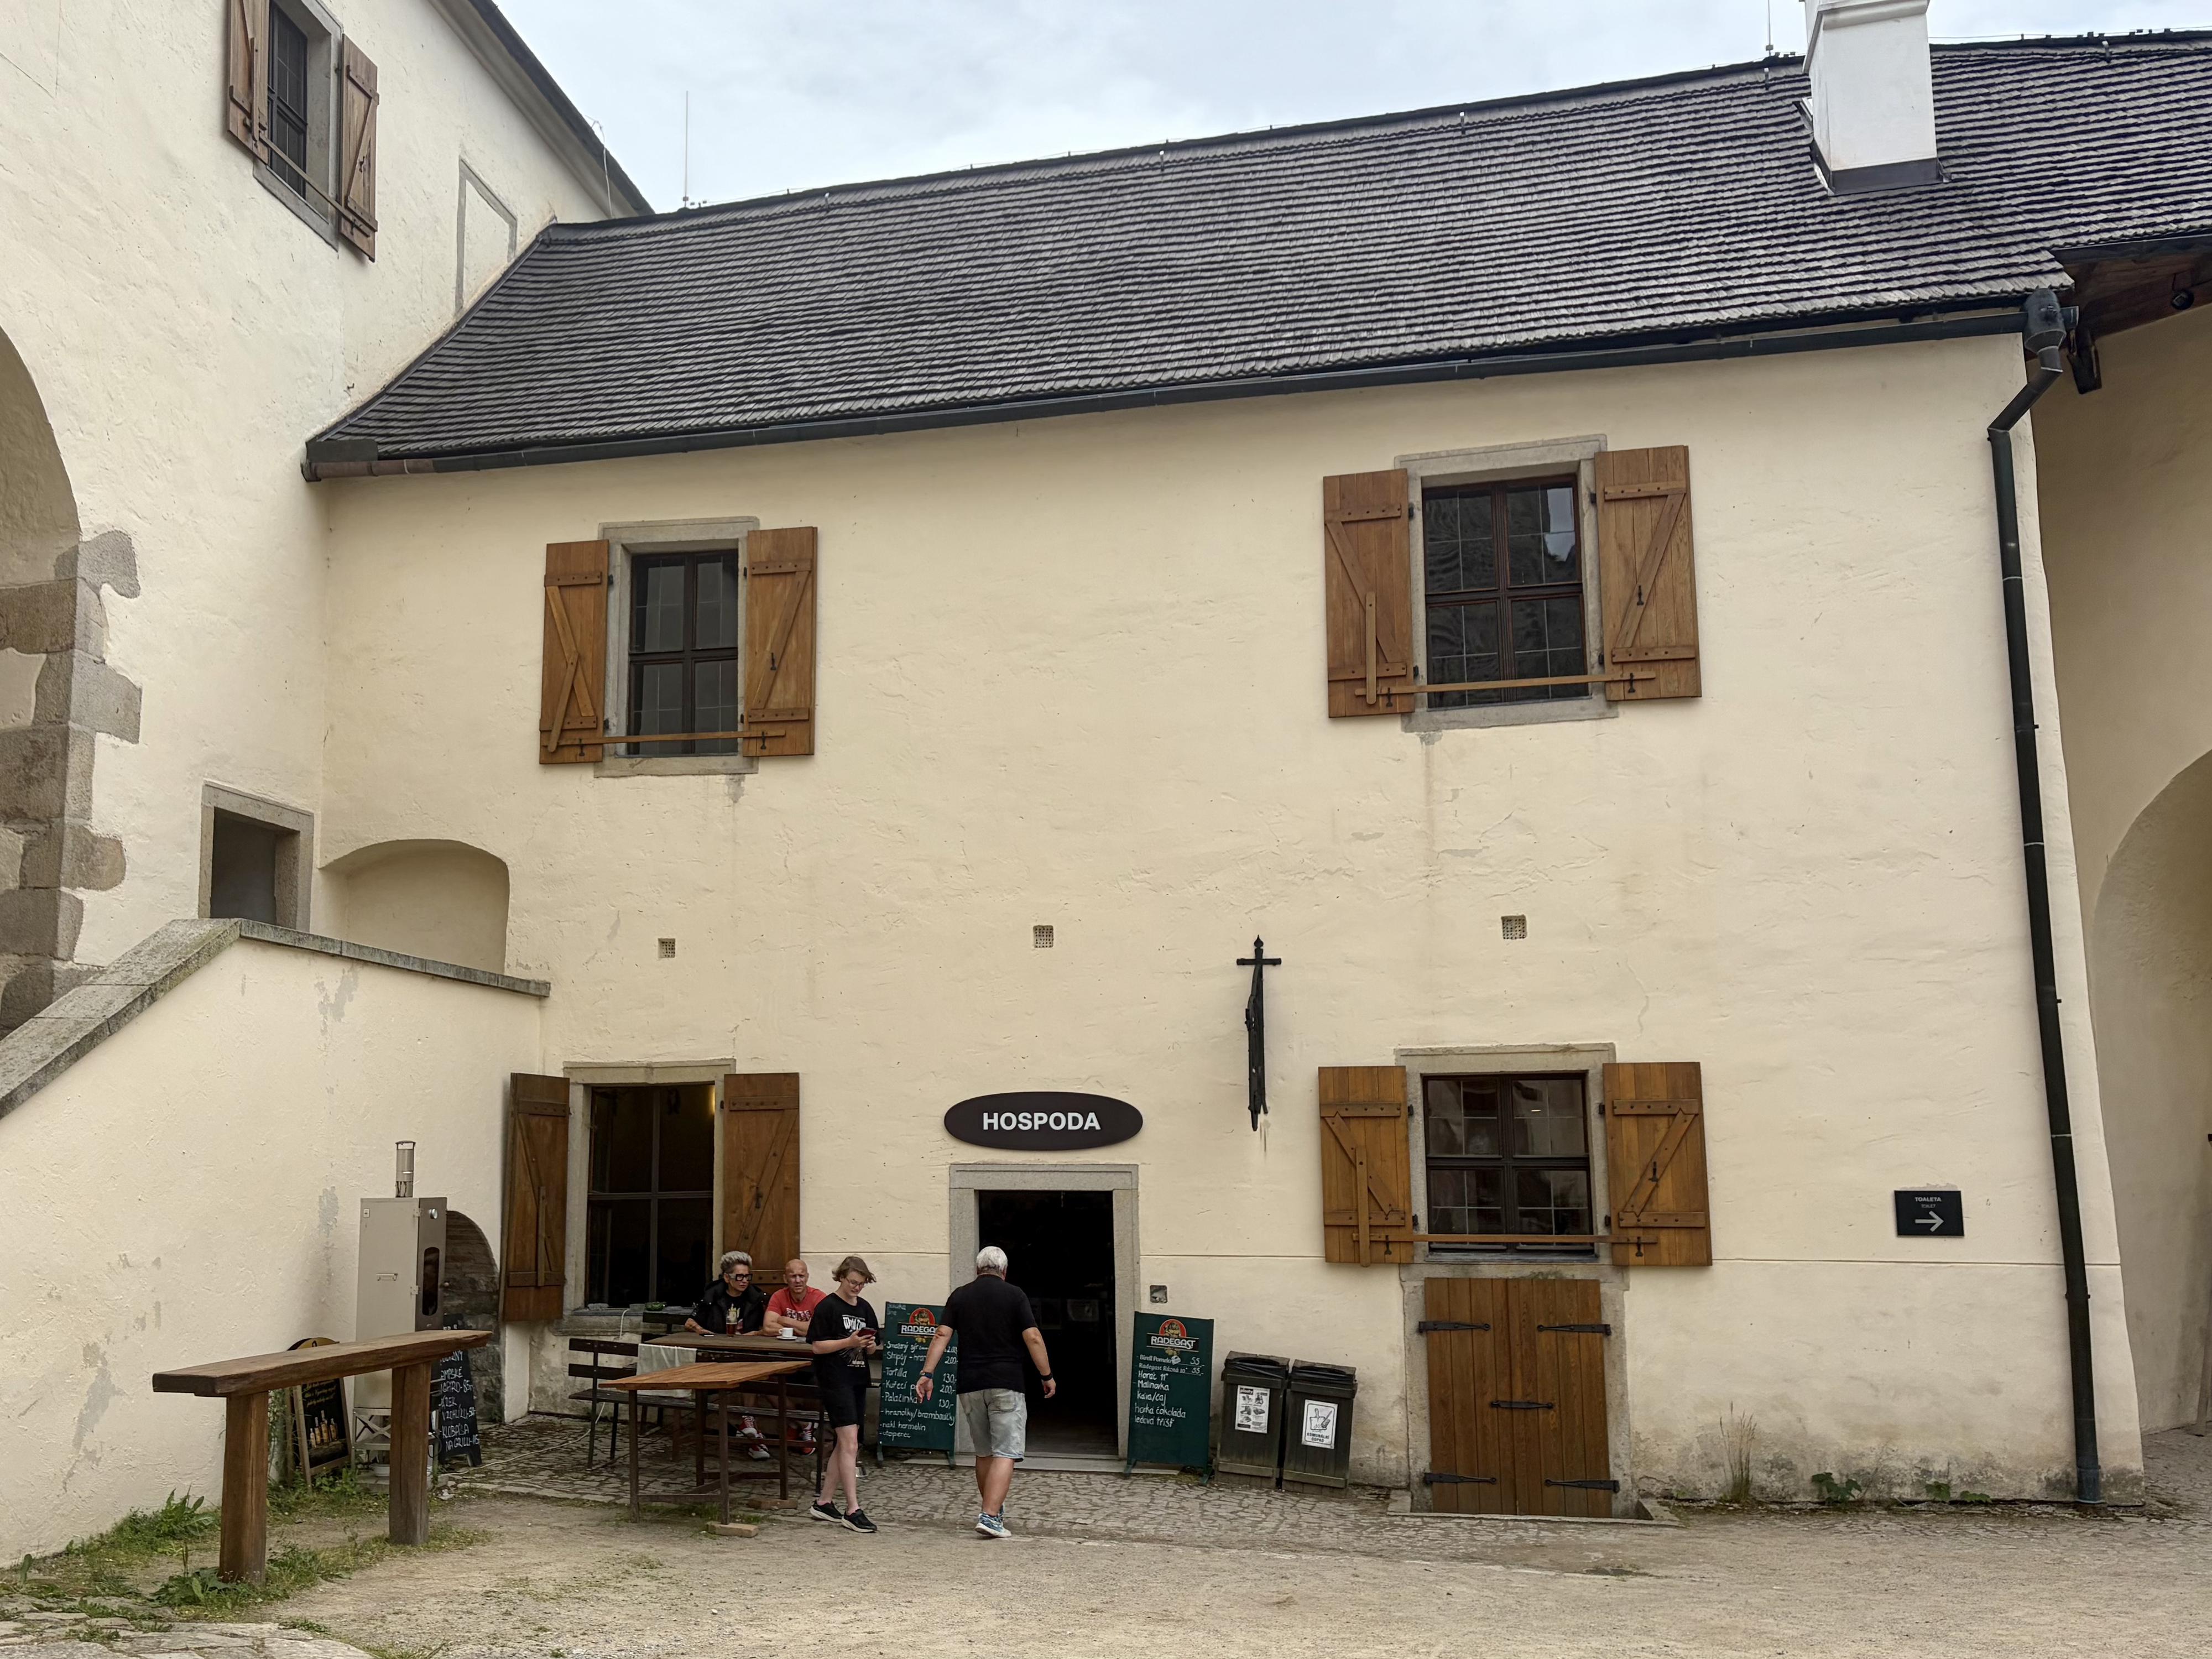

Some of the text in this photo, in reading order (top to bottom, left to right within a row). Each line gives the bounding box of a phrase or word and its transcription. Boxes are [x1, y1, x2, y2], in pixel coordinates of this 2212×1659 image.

[983, 1112, 1101, 1130] HOSPODA
[901, 1325, 937, 1335] RADEGA
[1151, 1336, 1196, 1349] RADEGAST
